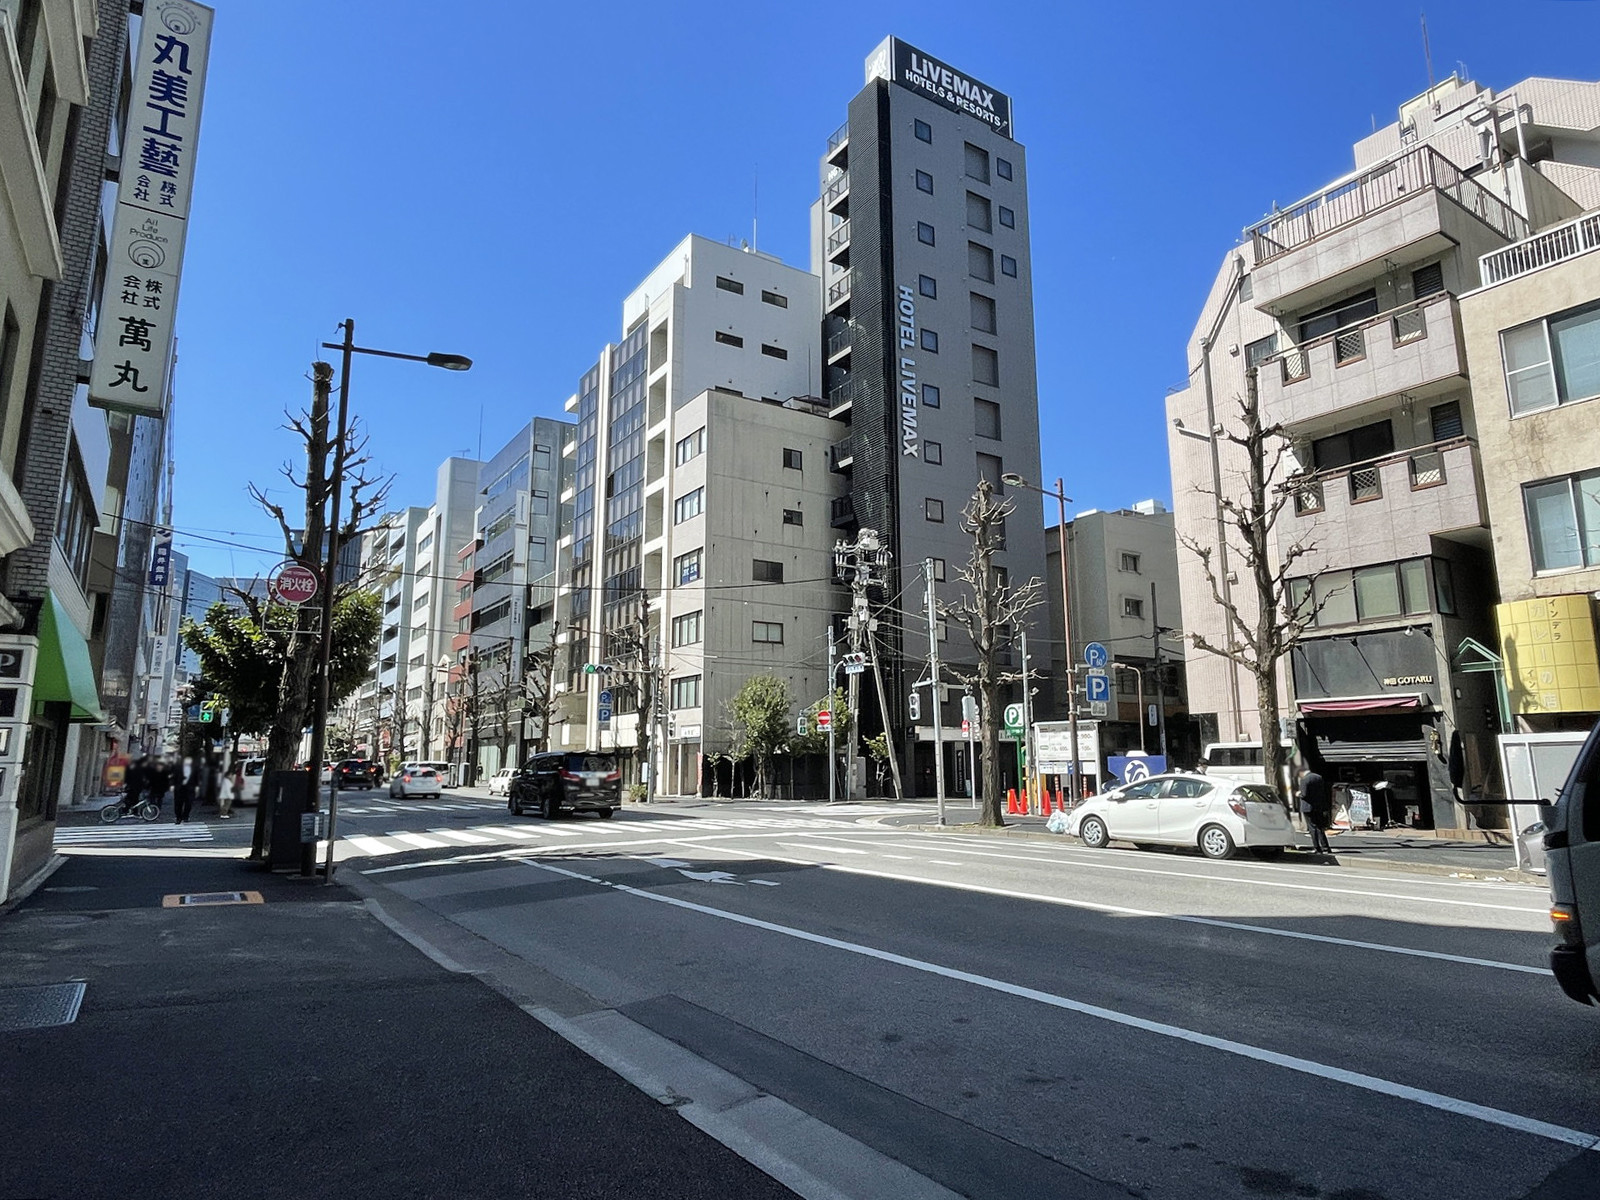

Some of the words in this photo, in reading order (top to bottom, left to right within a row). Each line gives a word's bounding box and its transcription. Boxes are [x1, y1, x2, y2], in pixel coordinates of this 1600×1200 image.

[139, 33, 193, 178] 丸美工藝
[905, 69, 945, 98] HOTELS
[946, 91, 955, 104] &
[956, 97, 1001, 126] RESORTS
[121, 275, 141, 305] 会社
[142, 279, 163, 310] 株式
[899, 285, 915, 350] HOTEL
[108, 316, 157, 392] 萬丸
[279, 577, 314, 593] 消火栓
[1090, 650, 1099, 666] P
[1092, 678, 1105, 699] P
[1397, 675, 1433, 684] GOTARU
[602, 710, 609, 720] P
[1008, 708, 1017, 724] P
